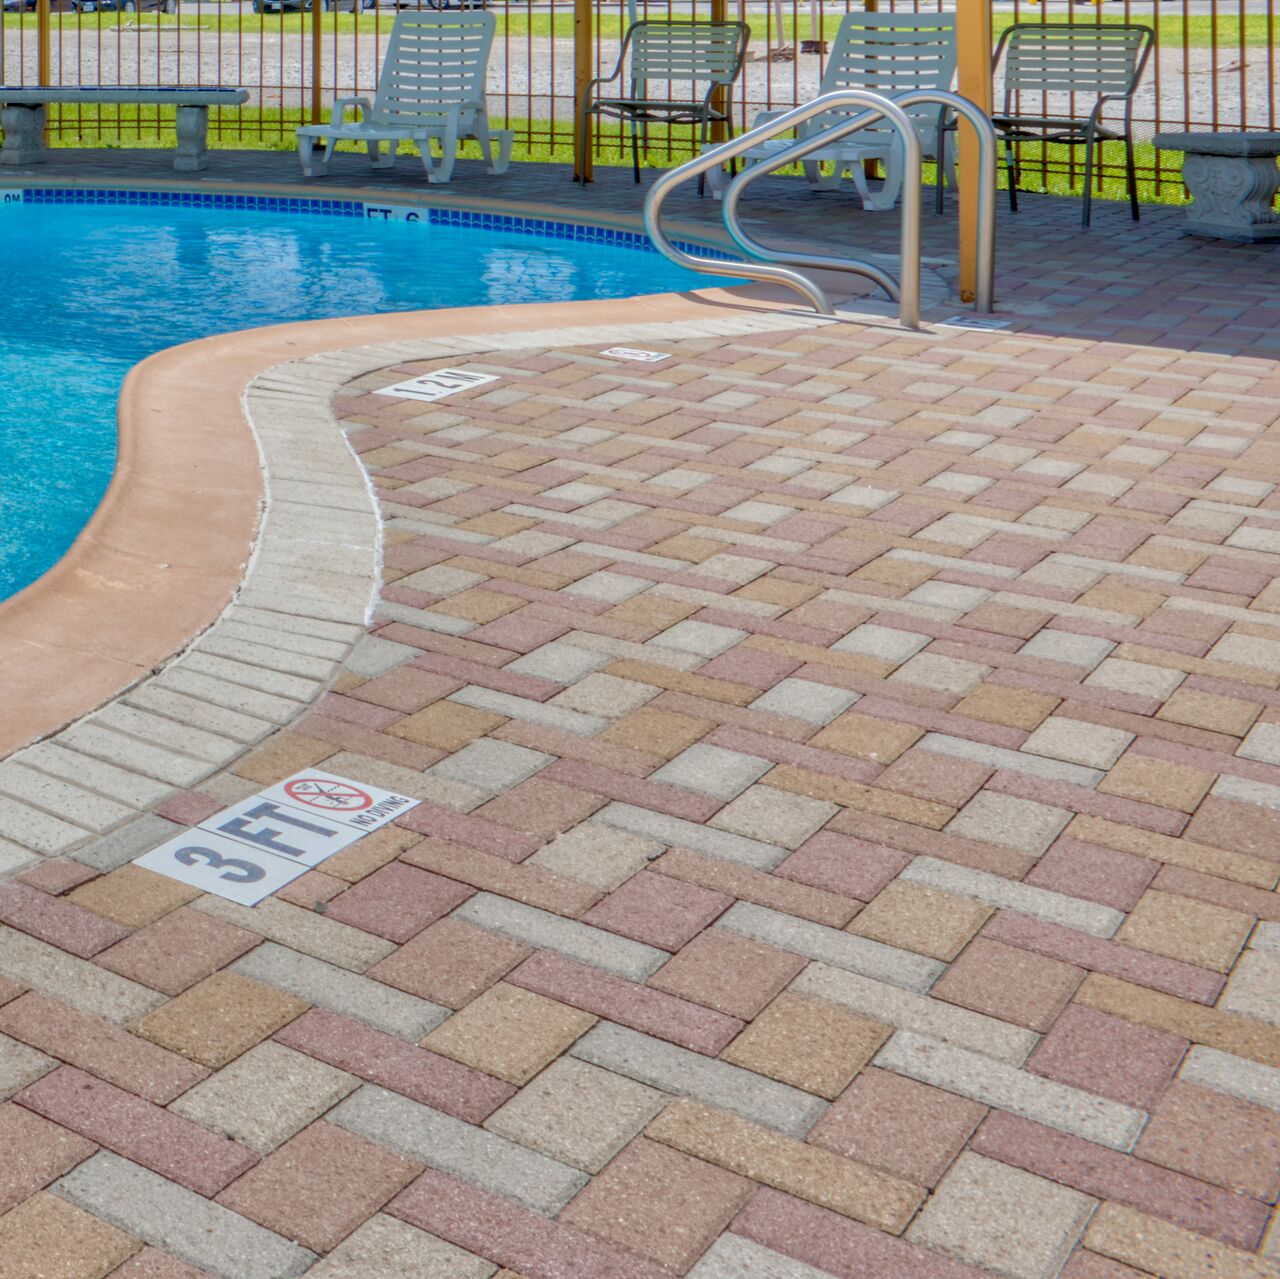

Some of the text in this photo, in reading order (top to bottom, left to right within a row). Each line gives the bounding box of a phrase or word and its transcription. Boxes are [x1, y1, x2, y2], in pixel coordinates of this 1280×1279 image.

[349, 796, 410, 827] NO DIVING
[174, 802, 339, 883] 3 FT
